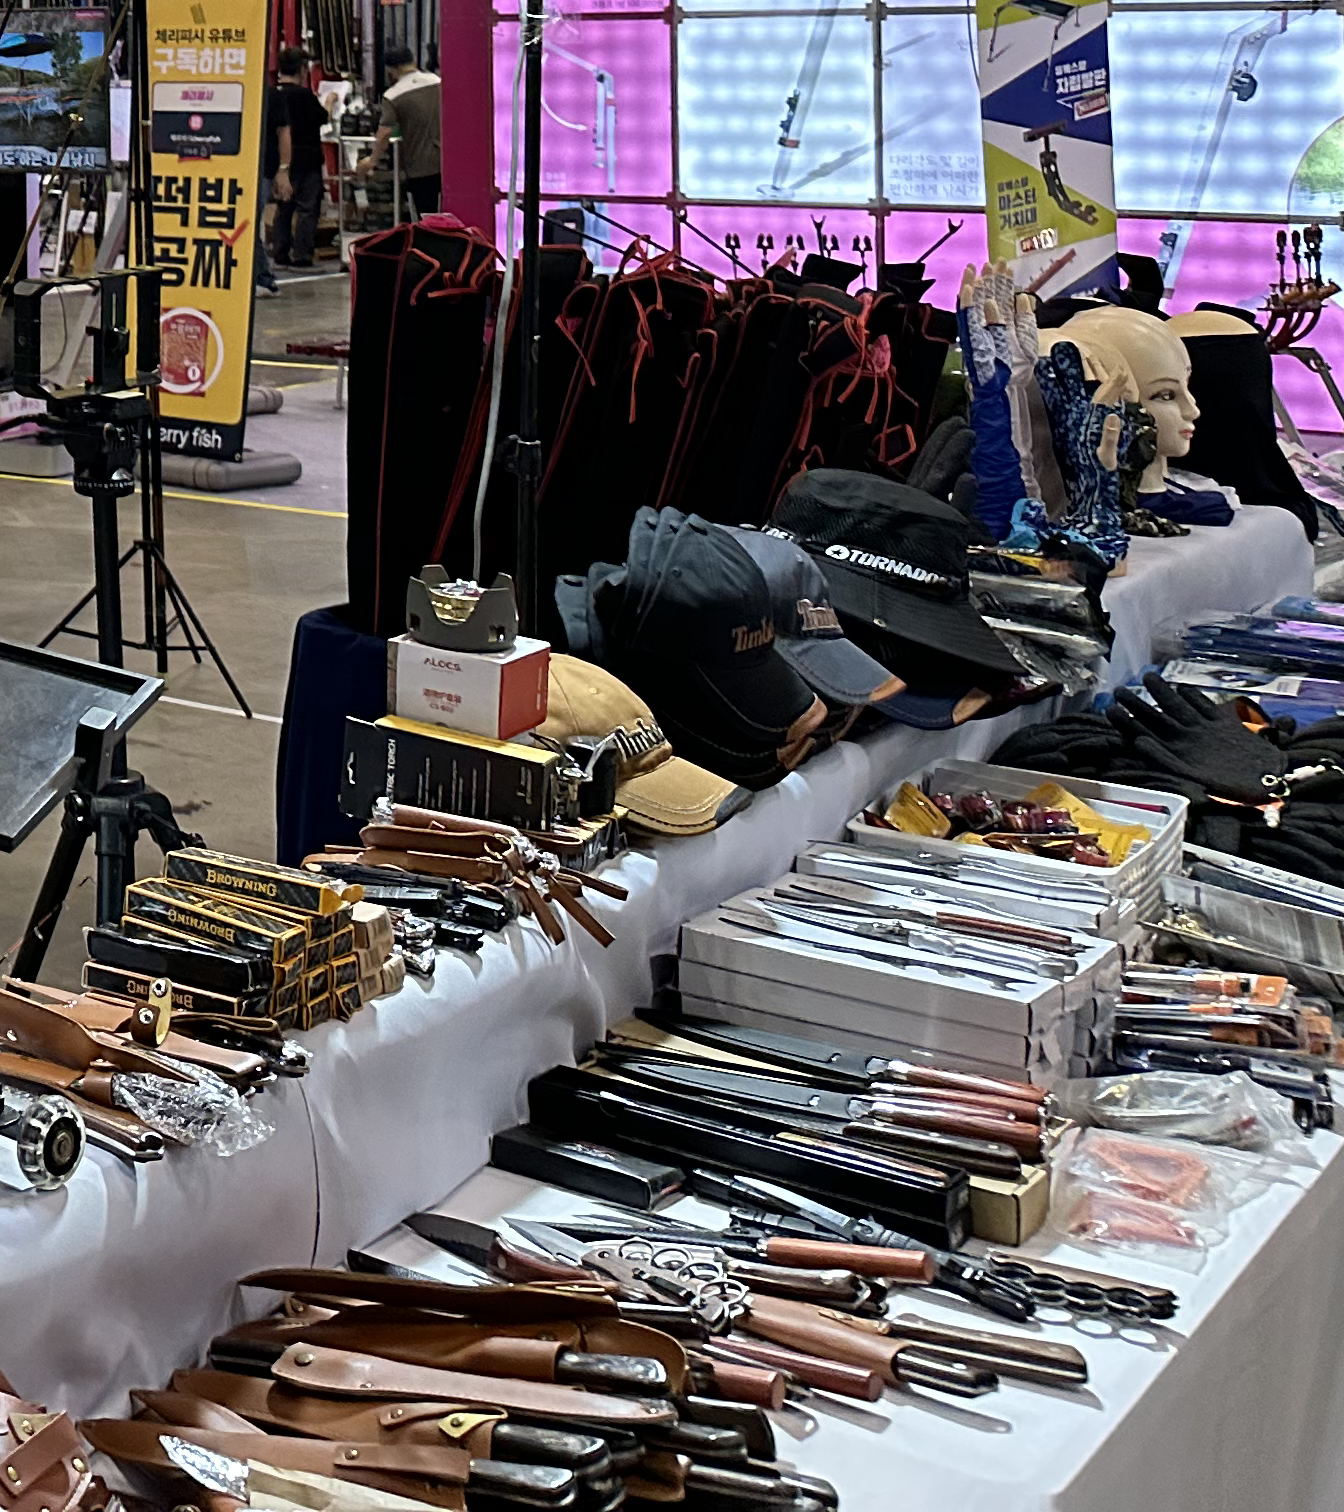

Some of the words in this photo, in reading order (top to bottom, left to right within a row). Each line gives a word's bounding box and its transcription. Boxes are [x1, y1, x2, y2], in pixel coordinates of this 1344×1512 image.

[154, 28, 206, 44] 체리피시
[207, 28, 247, 44] 유튜브
[153, 47, 248, 76] 구독하면
[152, 175, 243, 231] 떡밥
[154, 234, 239, 292] 공짜
[191, 427, 223, 450] fish
[423, 656, 464, 674] ALOCS
[205, 868, 278, 898] BROWNING
[167, 908, 236, 943] BROWNING
[126, 978, 195, 1010] BROING
